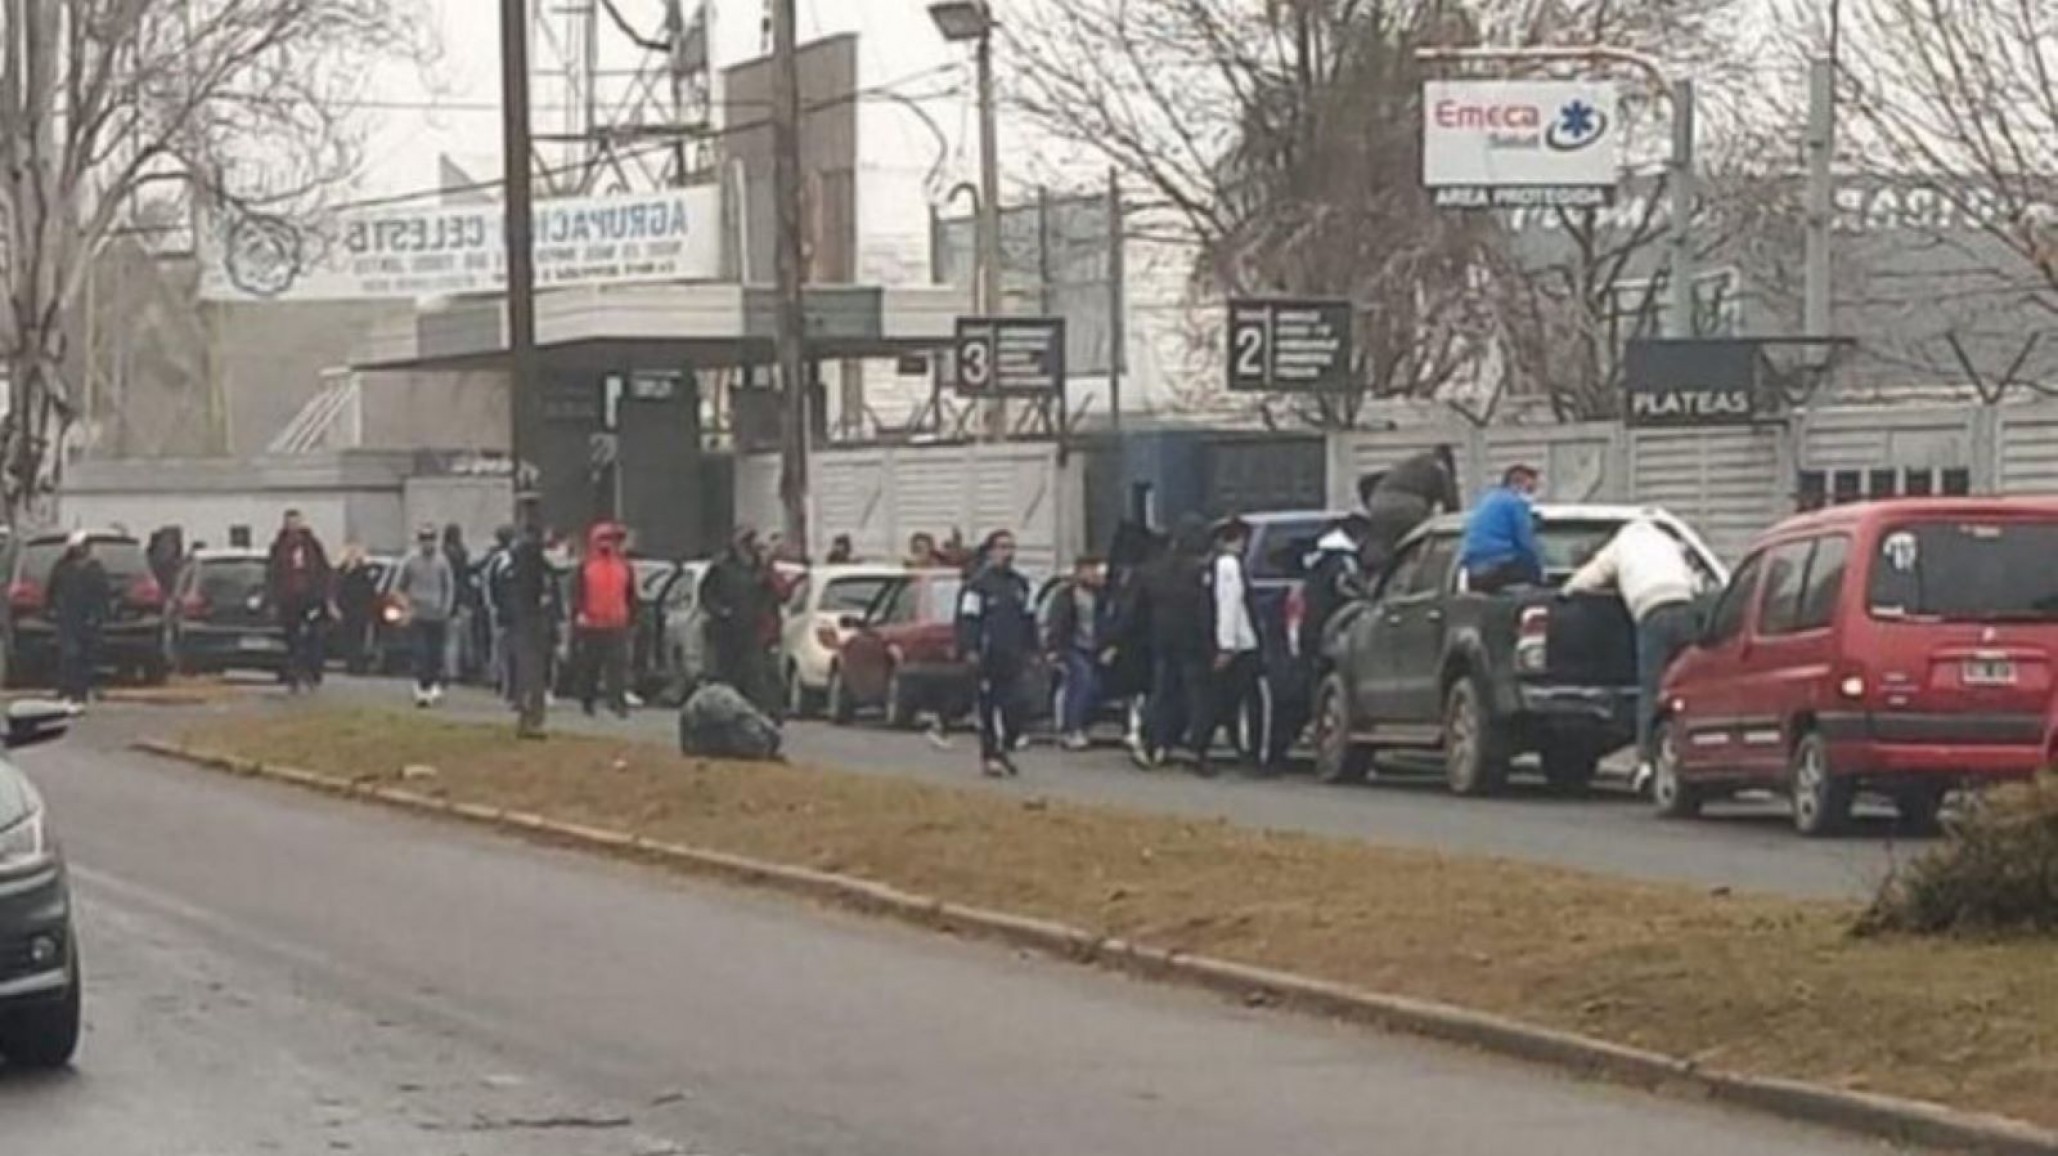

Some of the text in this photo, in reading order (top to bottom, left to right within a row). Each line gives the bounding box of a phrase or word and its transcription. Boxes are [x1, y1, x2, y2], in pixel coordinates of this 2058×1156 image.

[1435, 99, 1540, 129] Emeca
[962, 342, 988, 384] 3
[1236, 327, 1262, 374] 2
[1632, 390, 1748, 416] PLATEAS
